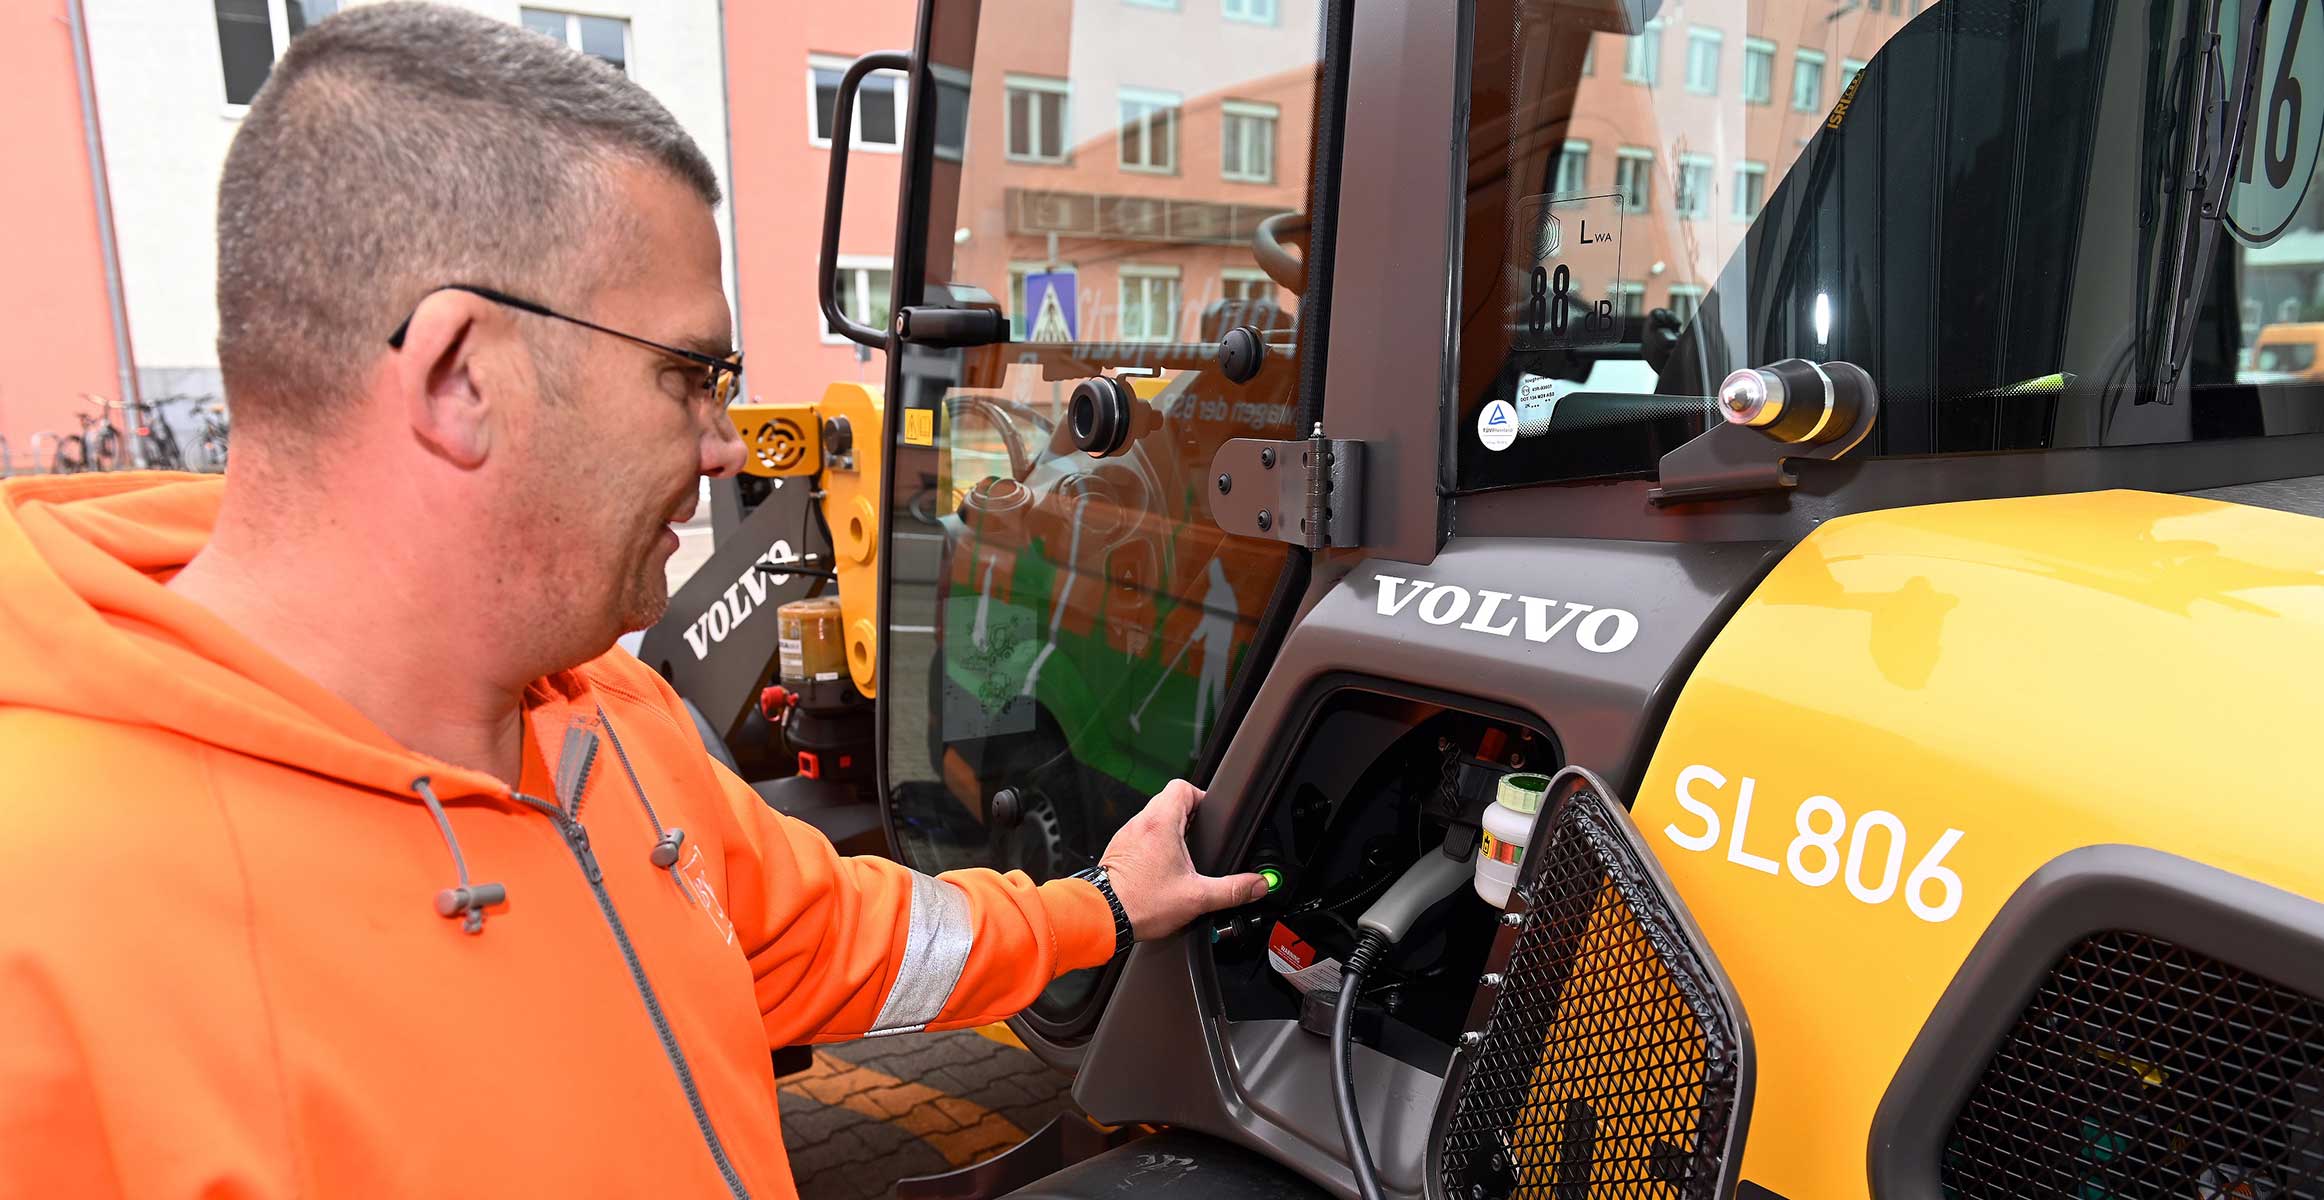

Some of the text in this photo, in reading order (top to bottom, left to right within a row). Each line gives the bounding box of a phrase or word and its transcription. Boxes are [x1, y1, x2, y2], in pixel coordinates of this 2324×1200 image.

[1826, 98, 1852, 129] ISRI
[1529, 264, 1613, 336] 88 dB
[683, 540, 793, 660] VOLVO
[1374, 574, 1639, 653] VOLVO
[1663, 764, 1966, 923] SL806
